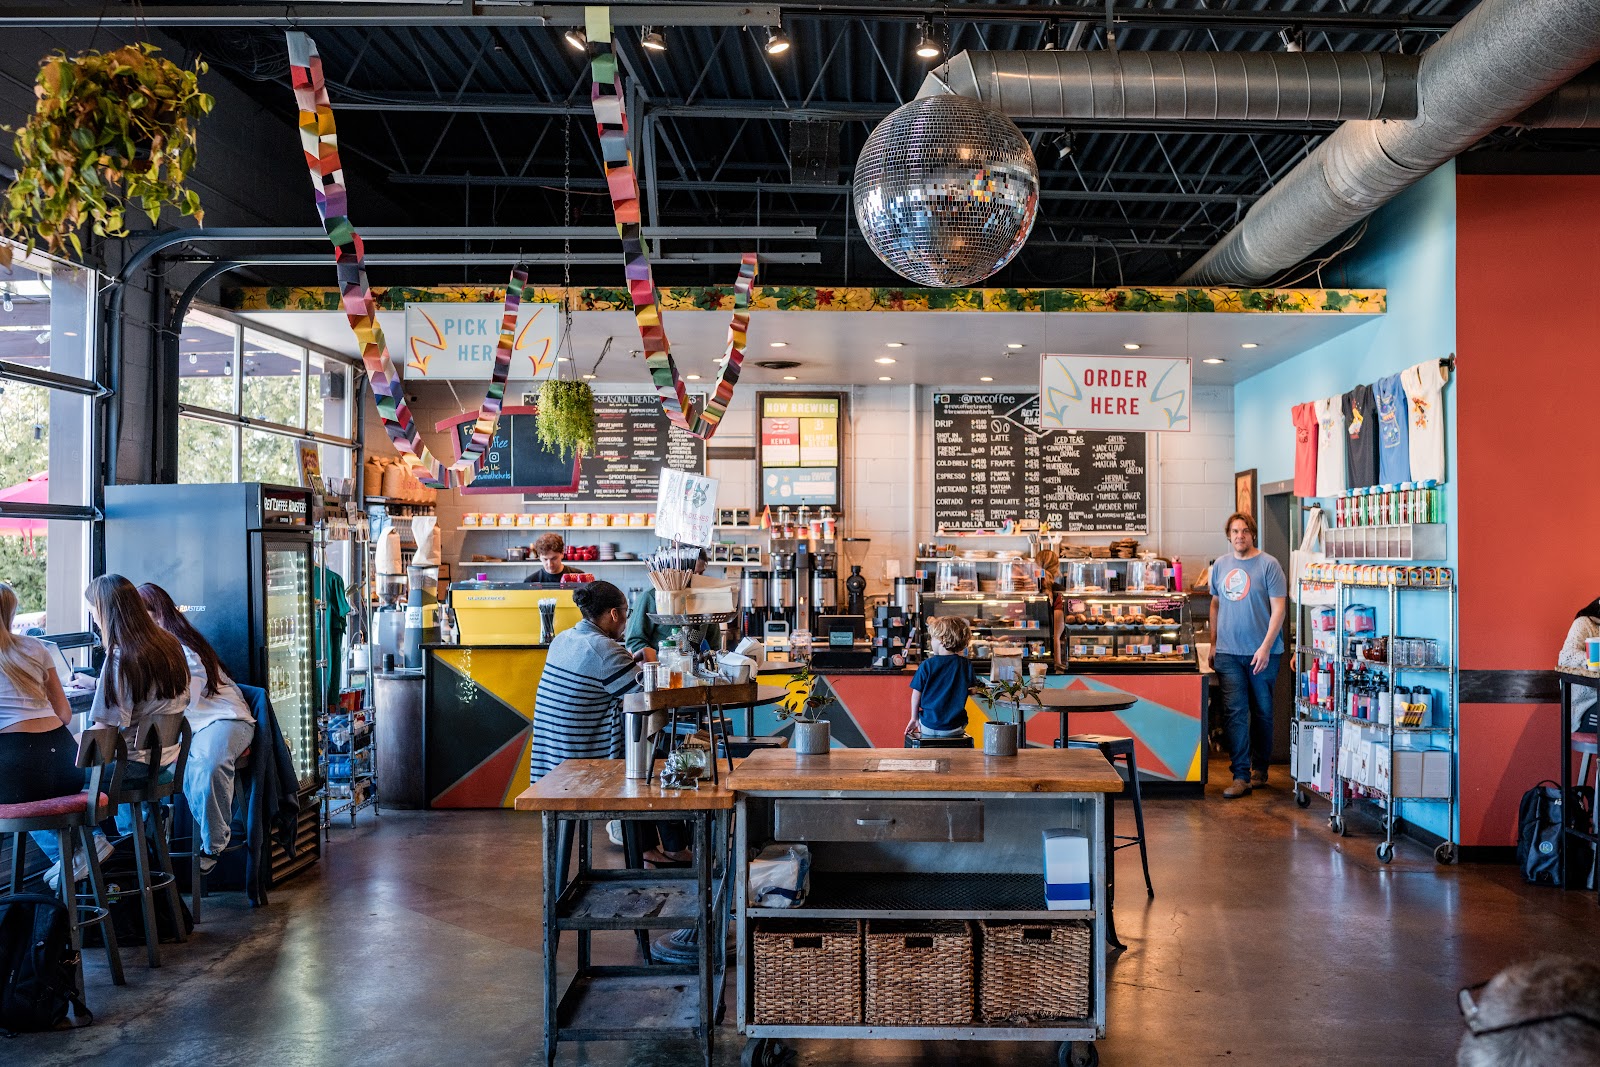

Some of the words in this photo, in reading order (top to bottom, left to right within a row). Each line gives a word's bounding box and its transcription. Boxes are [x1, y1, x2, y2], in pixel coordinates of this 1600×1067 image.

[444, 319, 487, 335] PICK
[458, 345, 492, 361] HER
[1084, 368, 1147, 388] ORDER
[598, 396, 630, 404] SEASONAL
[631, 396, 656, 404] TREATS
[1091, 397, 1140, 414] HERE
[766, 404, 788, 413] NOW
[791, 404, 836, 413] BREWING
[1066, 493, 1094, 501] BREAKFAST
[272, 498, 288, 512] COFFEE
[288, 500, 306, 513] ROASTERS
[1060, 502, 1074, 510] GREY
[1047, 514, 1062, 522] ADD
